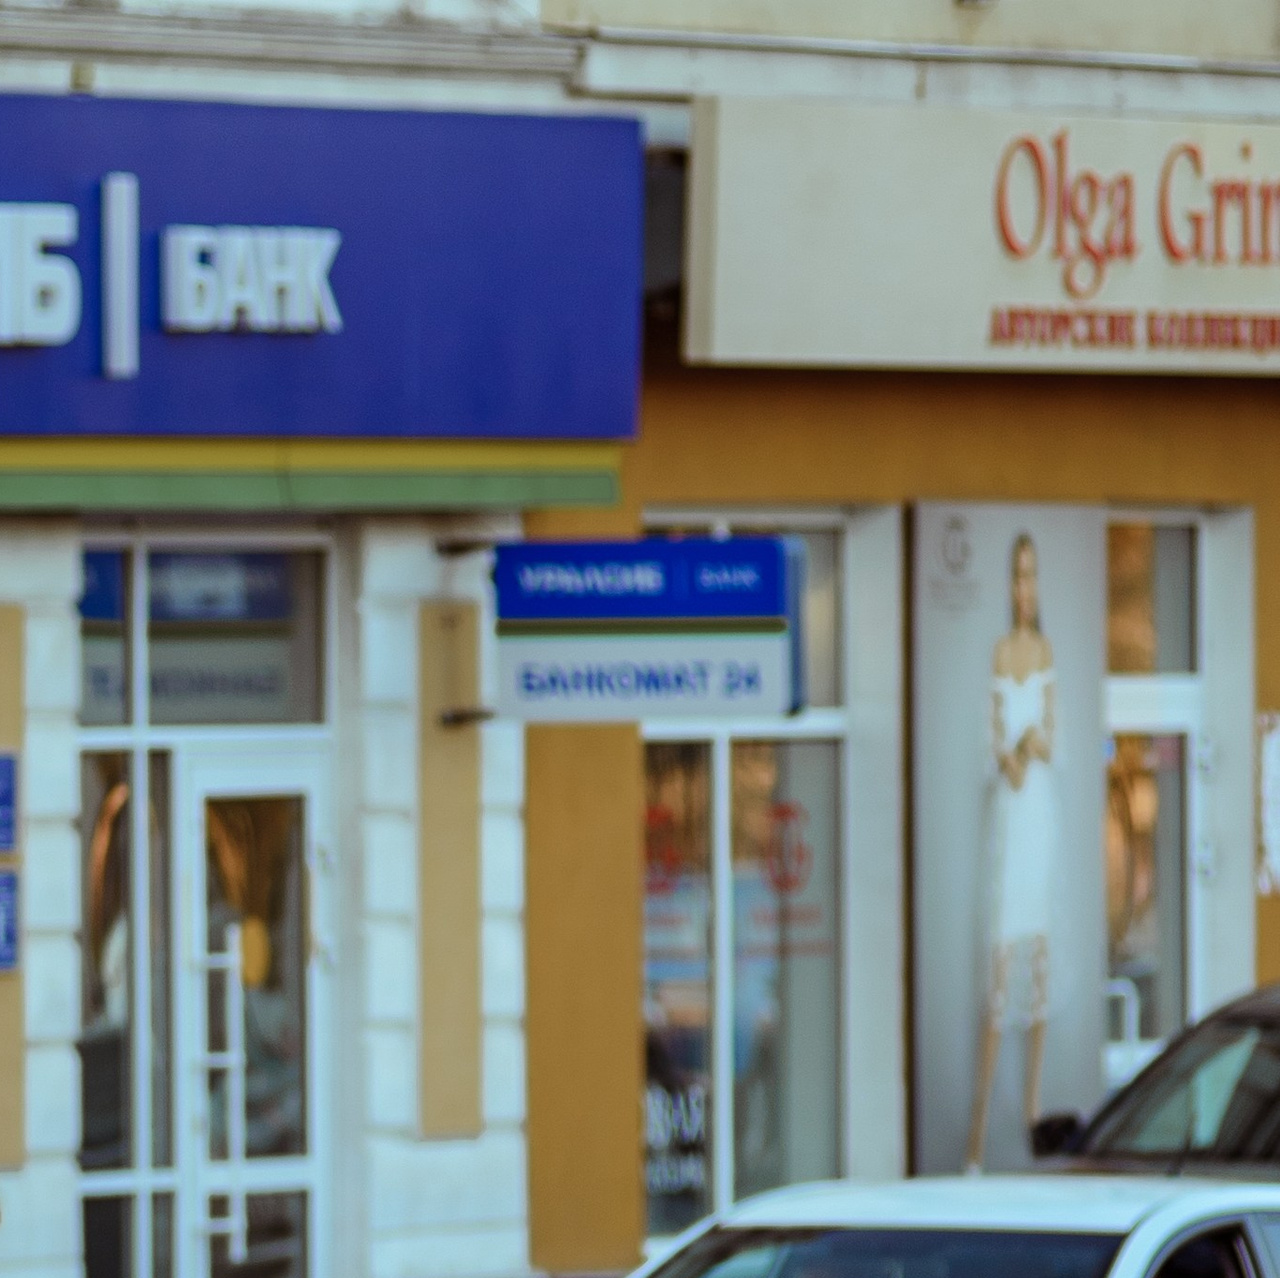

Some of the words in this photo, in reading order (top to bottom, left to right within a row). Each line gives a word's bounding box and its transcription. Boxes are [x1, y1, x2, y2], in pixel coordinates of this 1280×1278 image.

[993, 129, 1138, 301] Olga
[161, 224, 344, 333] БАНК
[520, 661, 709, 698] БАНКОМАТ
